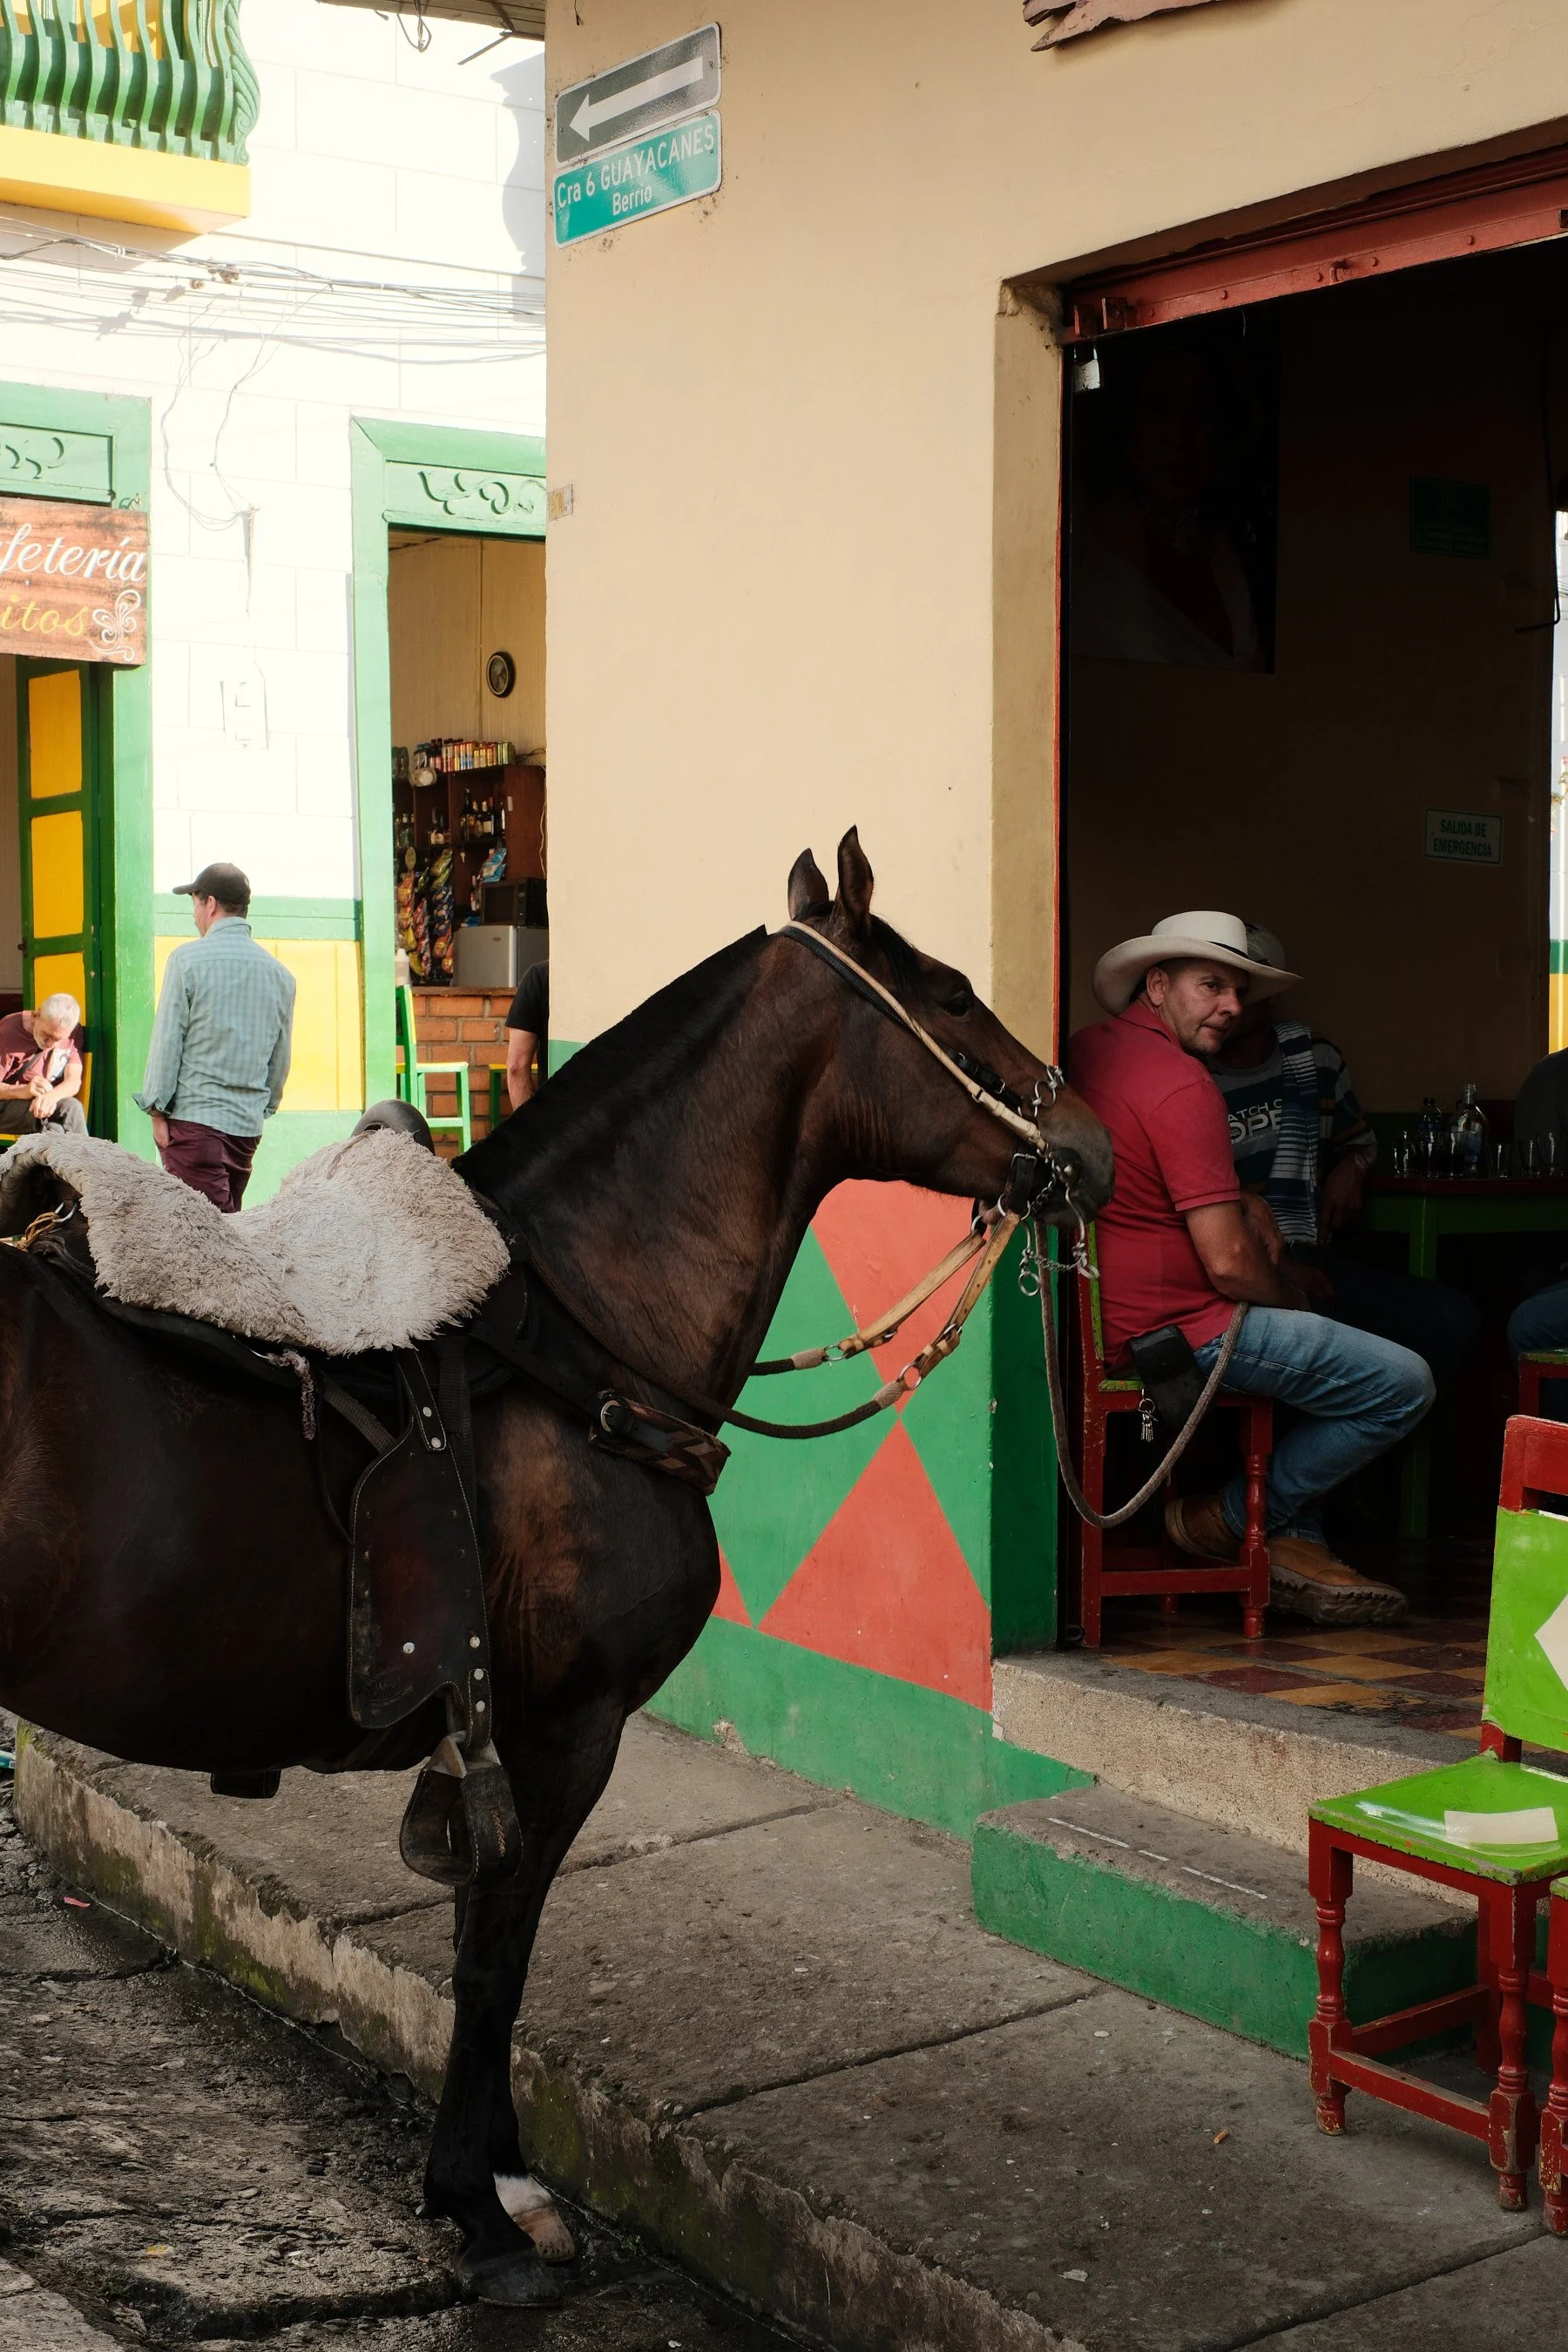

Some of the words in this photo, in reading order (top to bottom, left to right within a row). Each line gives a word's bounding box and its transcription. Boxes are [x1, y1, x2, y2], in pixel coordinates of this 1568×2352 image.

[558, 183, 581, 207] Cra
[585, 172, 596, 197] 6
[601, 125, 714, 191] GUAYACANES
[0, 523, 147, 582] fetería
[1440, 819, 1472, 836] SALIDA
[1475, 823, 1487, 837] DE
[1433, 838, 1492, 858] EMERGENCIA
